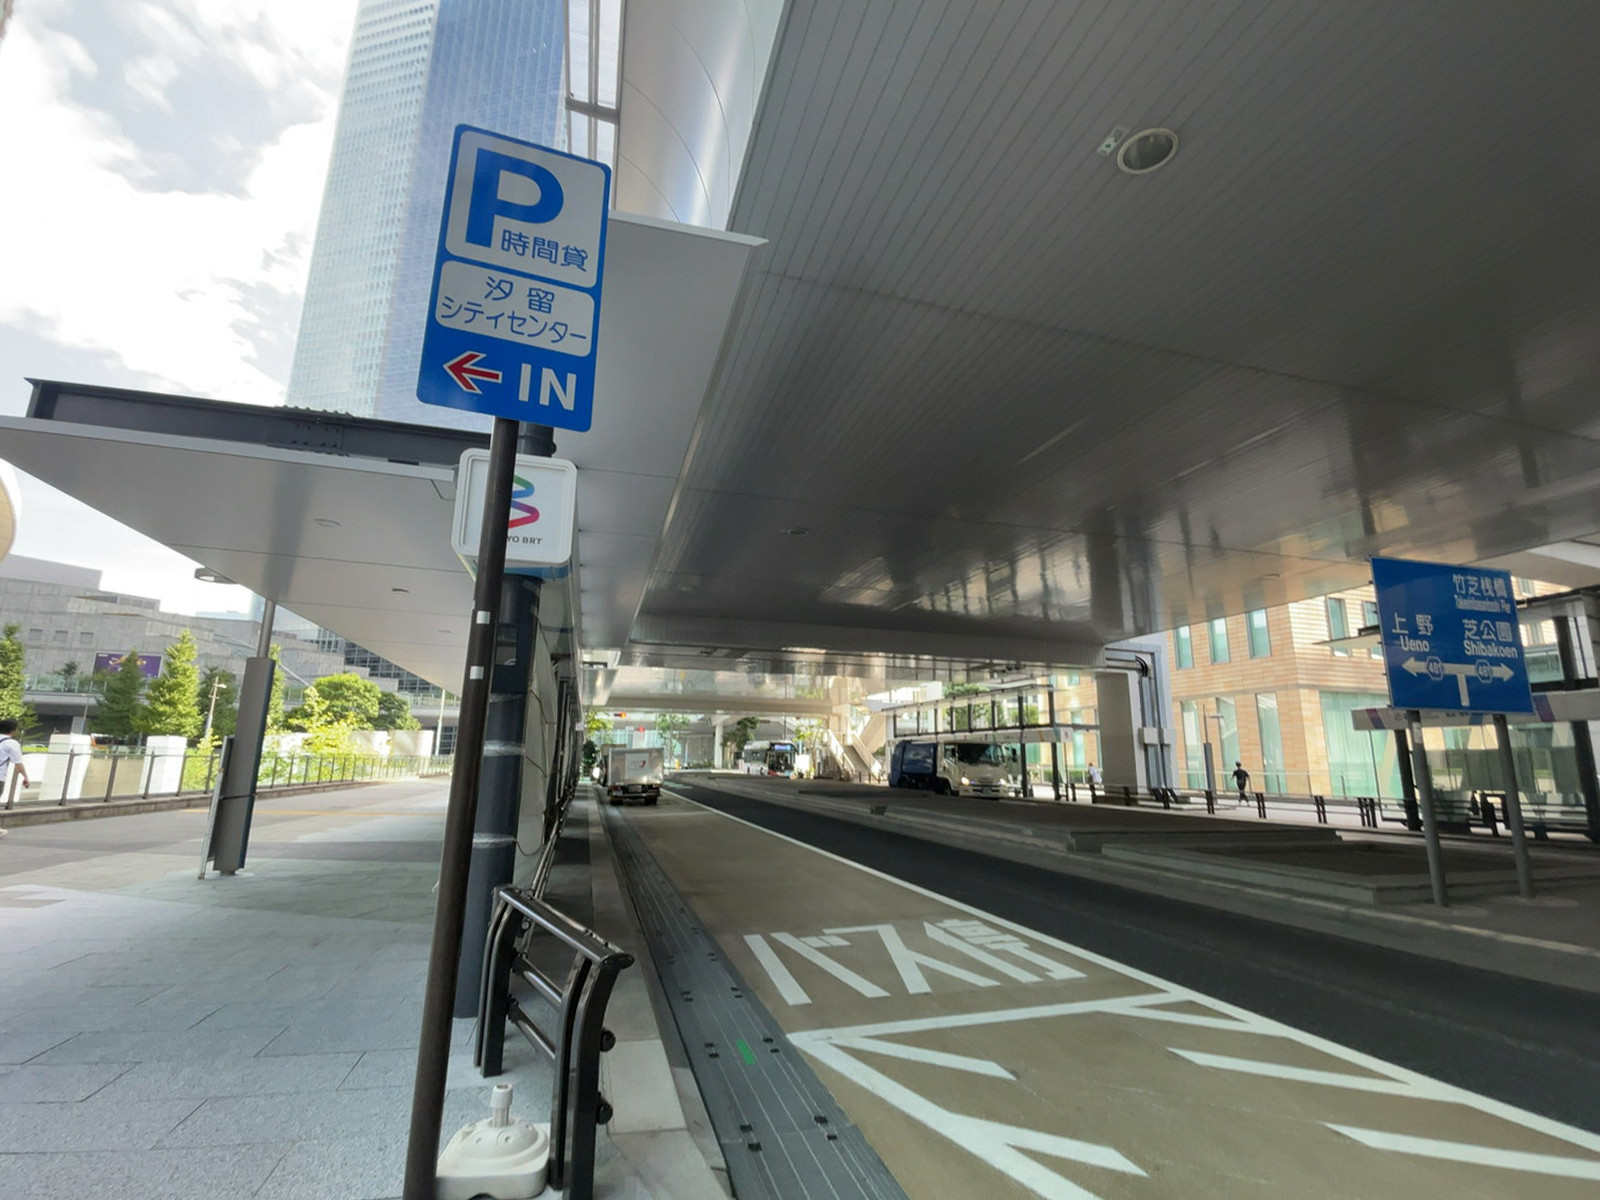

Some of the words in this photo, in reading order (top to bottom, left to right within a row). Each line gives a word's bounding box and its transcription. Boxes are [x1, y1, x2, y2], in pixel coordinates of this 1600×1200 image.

[465, 148, 564, 248] P
[502, 229, 589, 272] 時間貸
[484, 276, 555, 314] 汐留
[441, 296, 587, 343] シティセンター
[518, 363, 577, 411] IN
[522, 536, 543, 544] BRT
[1392, 612, 1433, 636] 上野
[1462, 618, 1513, 643] 芝公園
[1400, 635, 1430, 652] Ueno
[1463, 640, 1518, 659] Shibakoen
[743, 919, 1088, 1006] バス停
